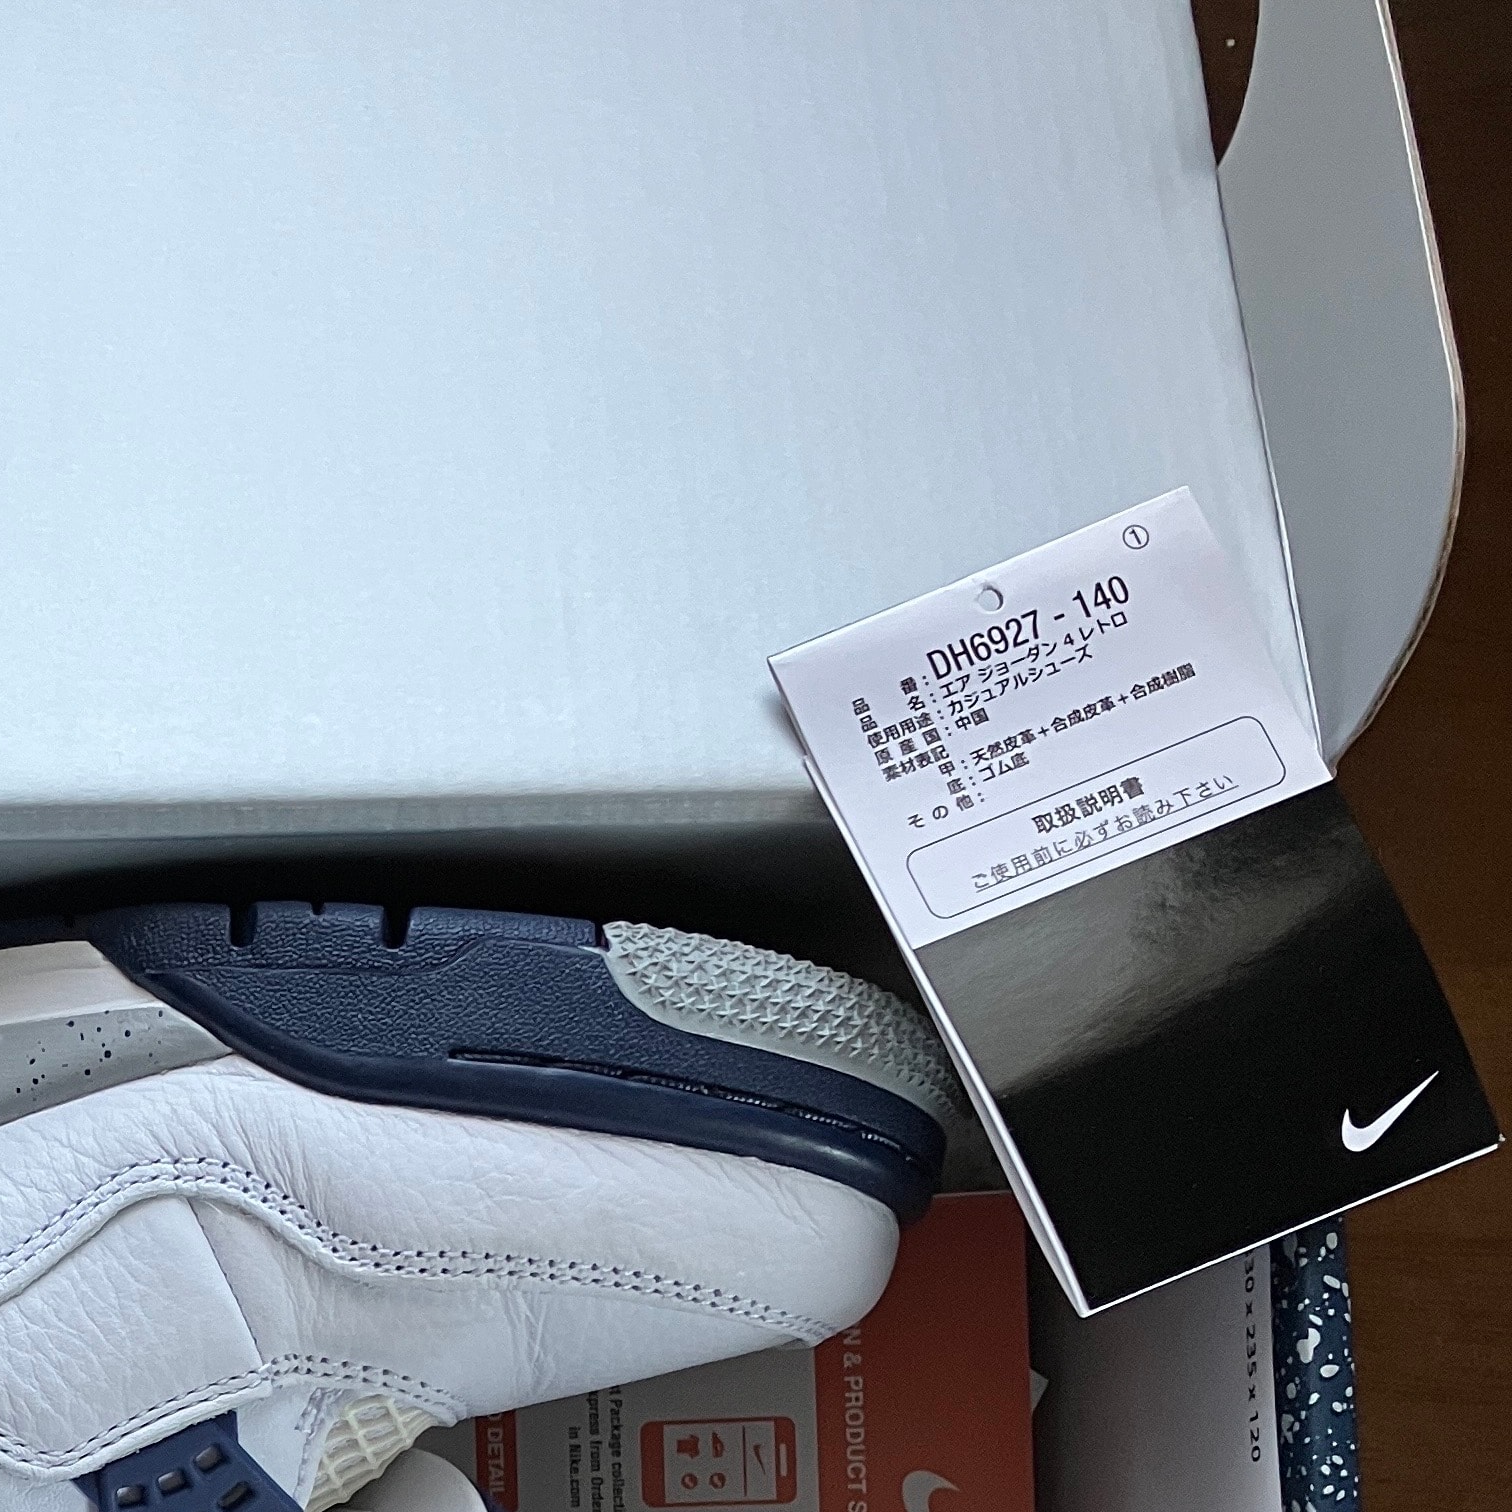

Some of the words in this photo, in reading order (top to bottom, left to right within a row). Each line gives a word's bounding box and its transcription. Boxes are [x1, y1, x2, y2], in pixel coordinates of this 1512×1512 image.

[926, 609, 1040, 682] DH6927
[1072, 575, 1130, 618] 140
[955, 708, 990, 732] 中国
[1031, 776, 1145, 835] 取扱説明書
[843, 1351, 862, 1369] &
[1246, 1324, 1258, 1379] 235
[569, 1426, 582, 1440] in
[608, 1399, 624, 1458] Package
[843, 1375, 868, 1494] PRODUCT
[1249, 1410, 1262, 1463] 120
[568, 1443, 582, 1508] Nike.com
[589, 1440, 603, 1473] from
